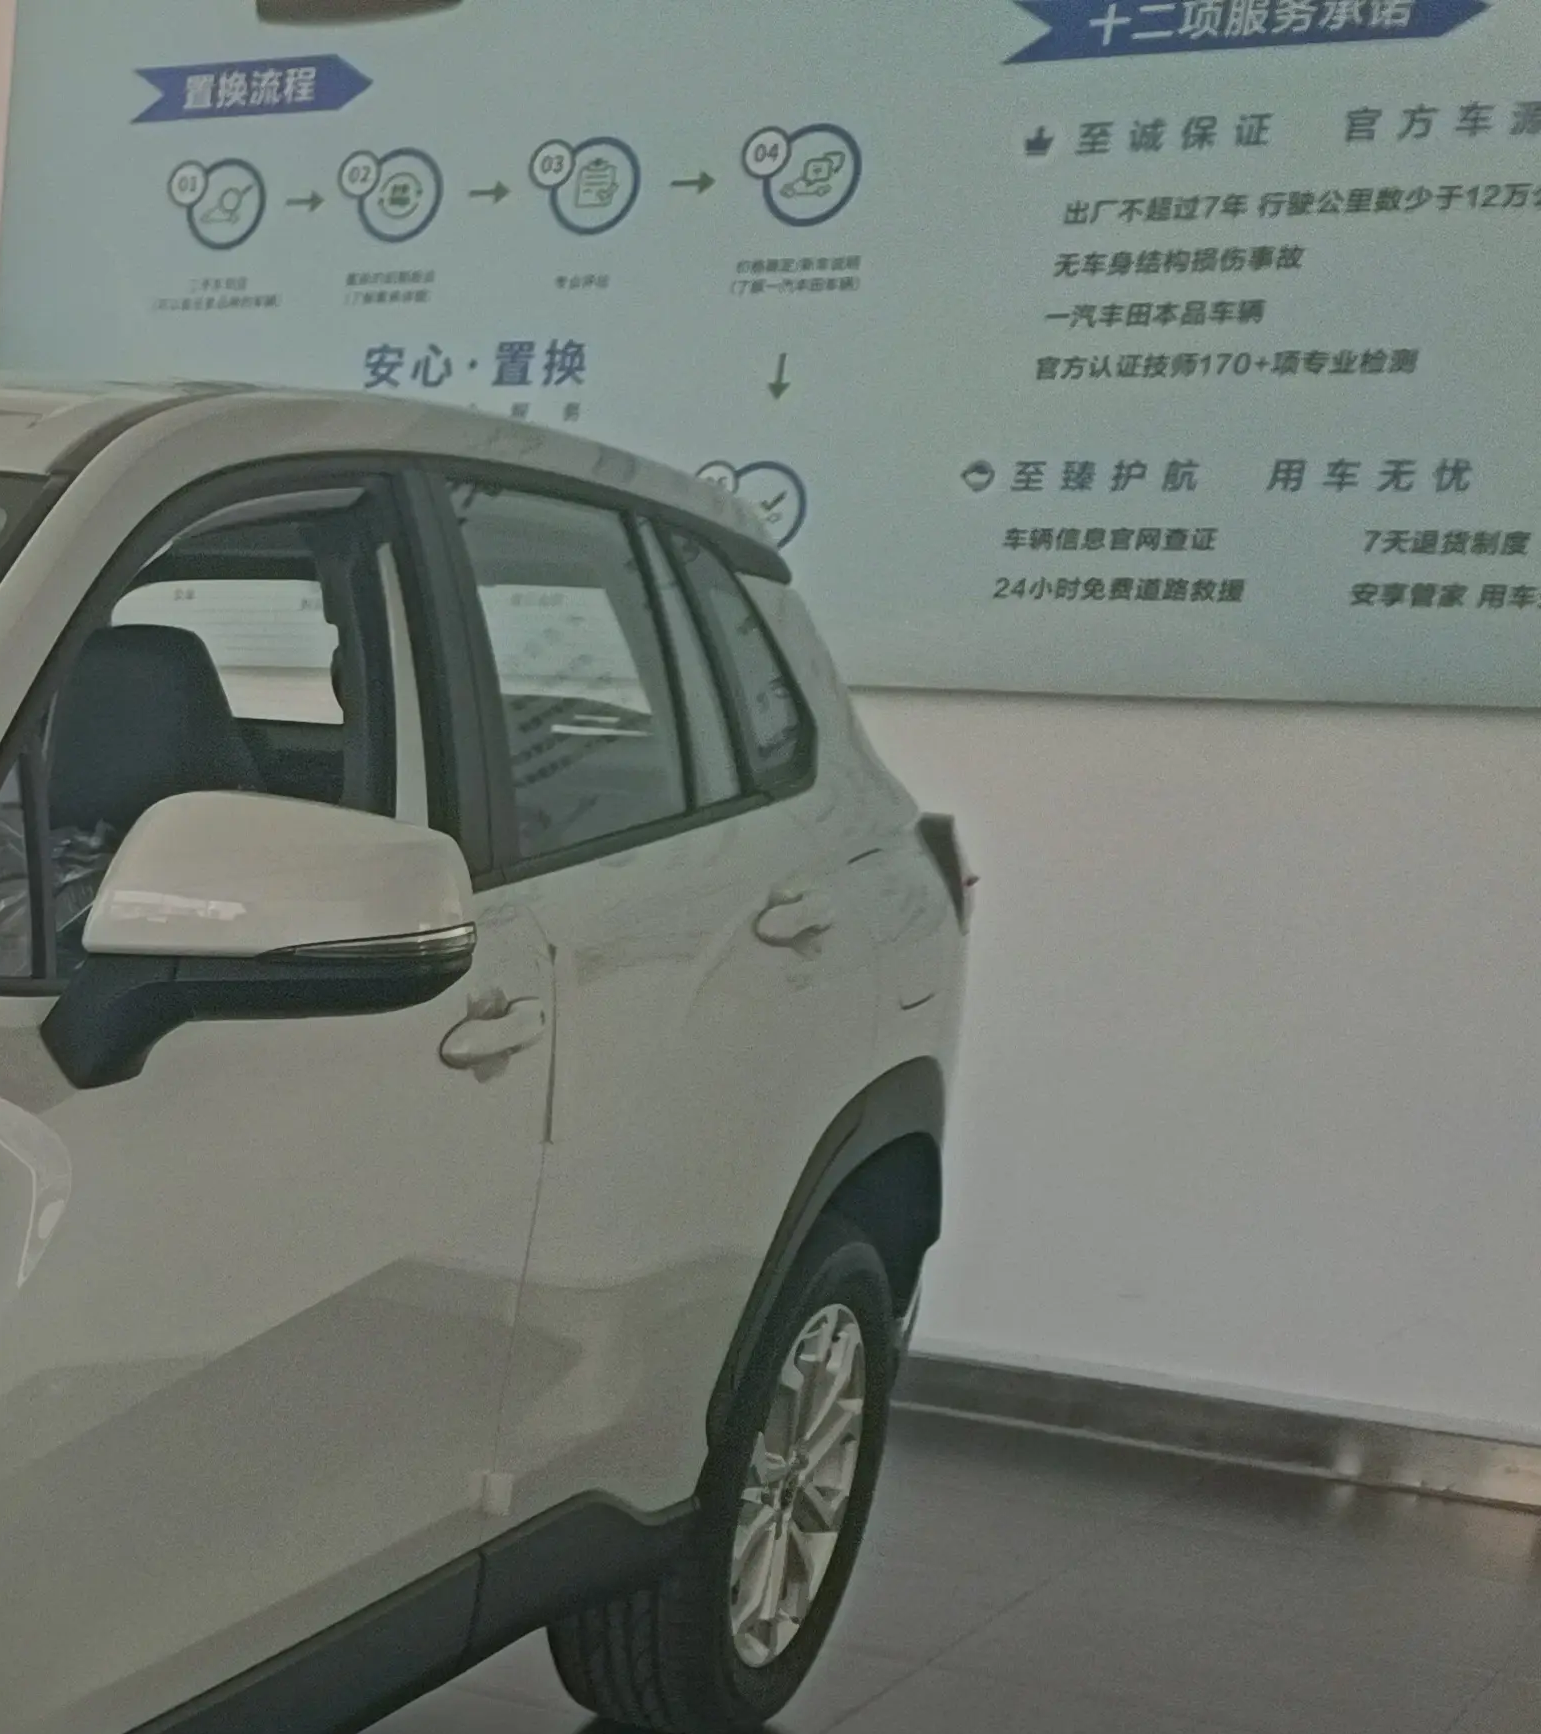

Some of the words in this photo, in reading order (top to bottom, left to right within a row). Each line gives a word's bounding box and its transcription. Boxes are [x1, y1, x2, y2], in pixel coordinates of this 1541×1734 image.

[1089, 0, 1412, 46] 十二项服务承诺
[183, 66, 317, 109] 置换流程
[1075, 112, 1273, 155] 至诚保证
[541, 155, 564, 174] 03
[754, 144, 779, 163] 04
[348, 166, 371, 184] 02
[1064, 194, 1249, 224] 出厂不超过7年
[1258, 182, 1541, 219] 行驶公里数少于12万
[1053, 244, 1305, 278] 无车身结构损伤事故
[1044, 299, 1266, 329] 一汽丰田本品车辆
[1035, 348, 1419, 381] 官方认证技师170+项专业检测
[1011, 459, 1199, 492] 至臻护航
[1266, 457, 1473, 492] 用车无忧
[1004, 527, 1219, 551] 车辆信息官网查证
[993, 576, 1246, 603] 24小时免费道路救援
[1477, 583, 1541, 610] 用车
